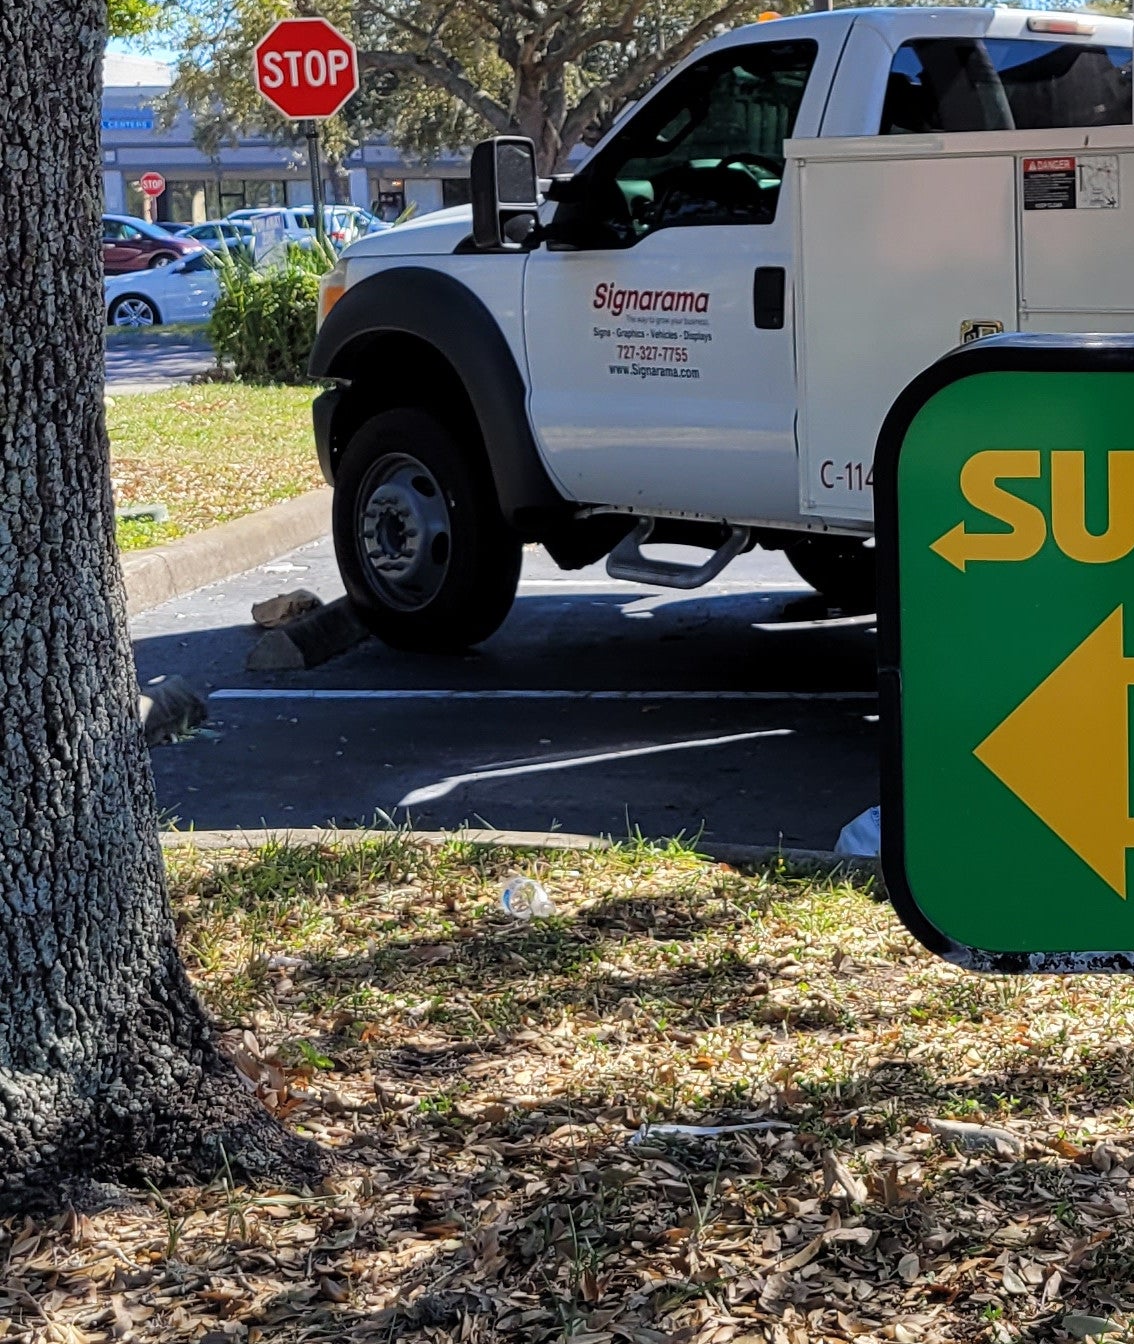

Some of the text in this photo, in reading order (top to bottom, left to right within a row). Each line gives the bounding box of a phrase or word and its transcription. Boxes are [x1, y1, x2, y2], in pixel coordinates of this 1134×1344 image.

[262, 49, 349, 89] STOP
[1036, 159, 1071, 171] DANGER
[142, 179, 163, 190] STOP
[593, 281, 711, 316] Signarama
[593, 327, 611, 339] Signs
[616, 328, 645, 340] Graphics
[650, 328, 678, 340] Vehicles
[684, 330, 713, 344] Displays
[617, 345, 689, 363] 727-327-7755
[608, 363, 700, 379] www.Signarama.com
